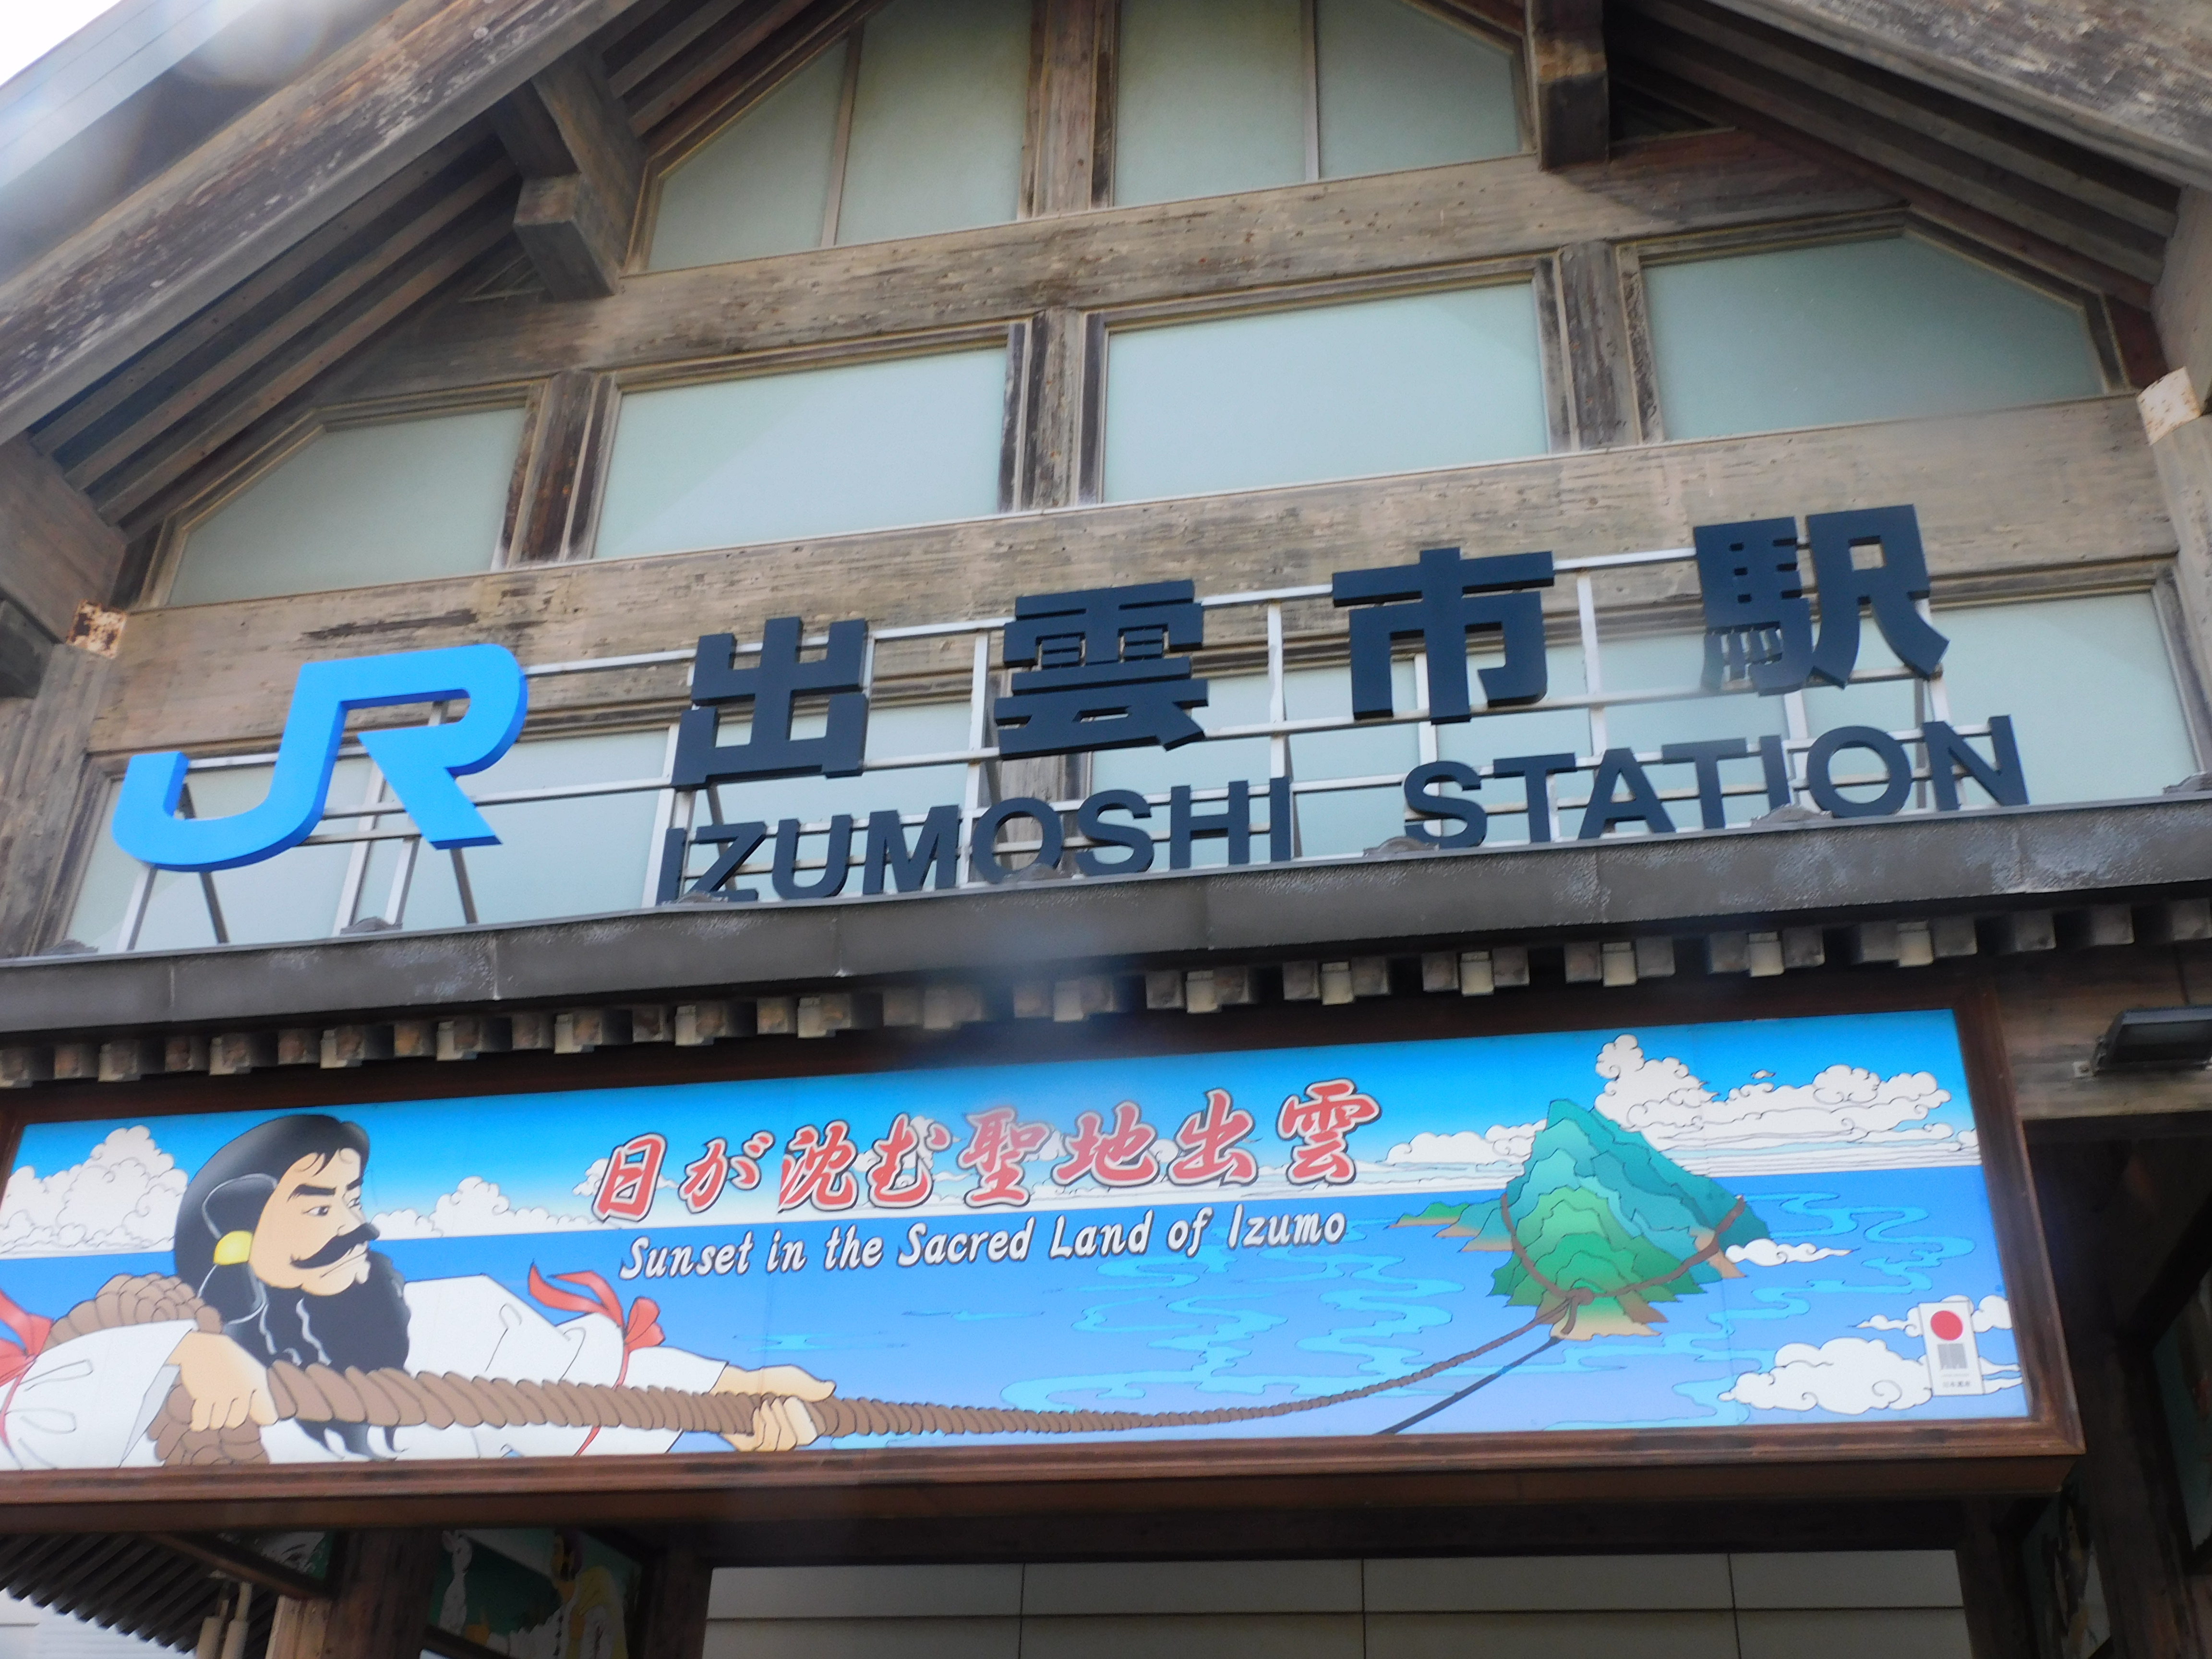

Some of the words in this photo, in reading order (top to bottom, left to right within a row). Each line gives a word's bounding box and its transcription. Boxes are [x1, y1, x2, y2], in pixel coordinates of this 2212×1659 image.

[111, 643, 528, 872] JR
[673, 504, 1949, 790] 出雲市駅
[656, 777, 1294, 905] IZUMOSHI
[1403, 715, 2029, 848] STATION
[592, 1078, 1382, 1222] 日が沈む聖地出雲
[619, 1230, 754, 1280] Sunset
[768, 1229, 807, 1273] in
[824, 1225, 884, 1270] the
[897, 1216, 1035, 1266] Sacred
[1048, 1210, 1154, 1260] Land
[1166, 1207, 1213, 1257] of
[1227, 1204, 1346, 1249] Izumo
